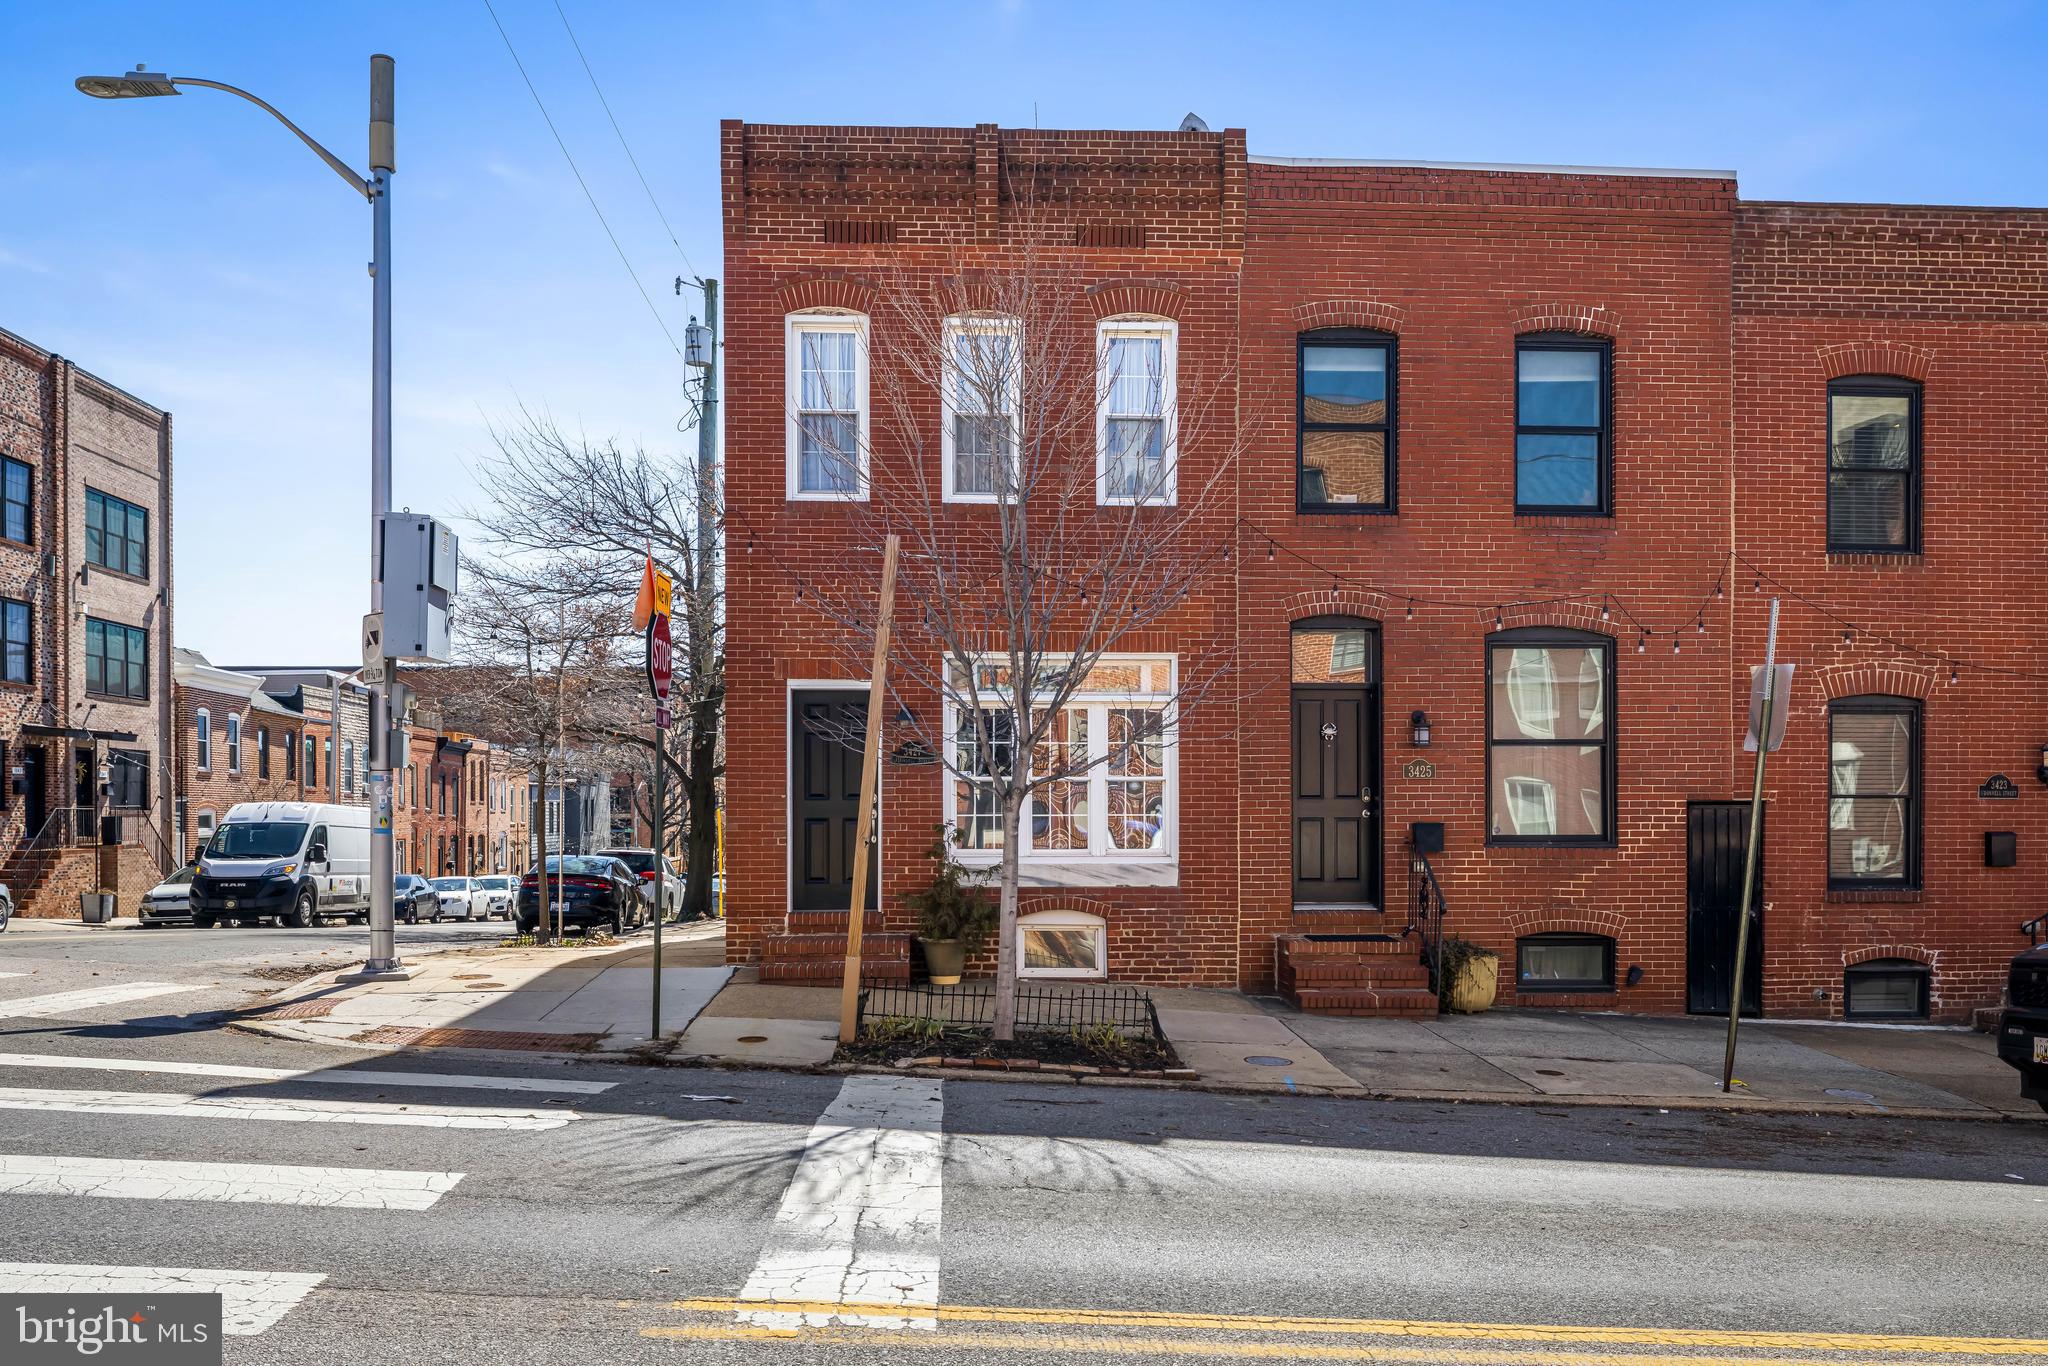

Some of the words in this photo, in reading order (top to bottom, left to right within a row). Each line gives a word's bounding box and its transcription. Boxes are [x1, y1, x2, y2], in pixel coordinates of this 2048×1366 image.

[657, 585, 669, 607] NEW
[653, 637, 671, 673] STOP
[1408, 765, 1432, 778] 3425
[1990, 780, 2008, 790] 3423
